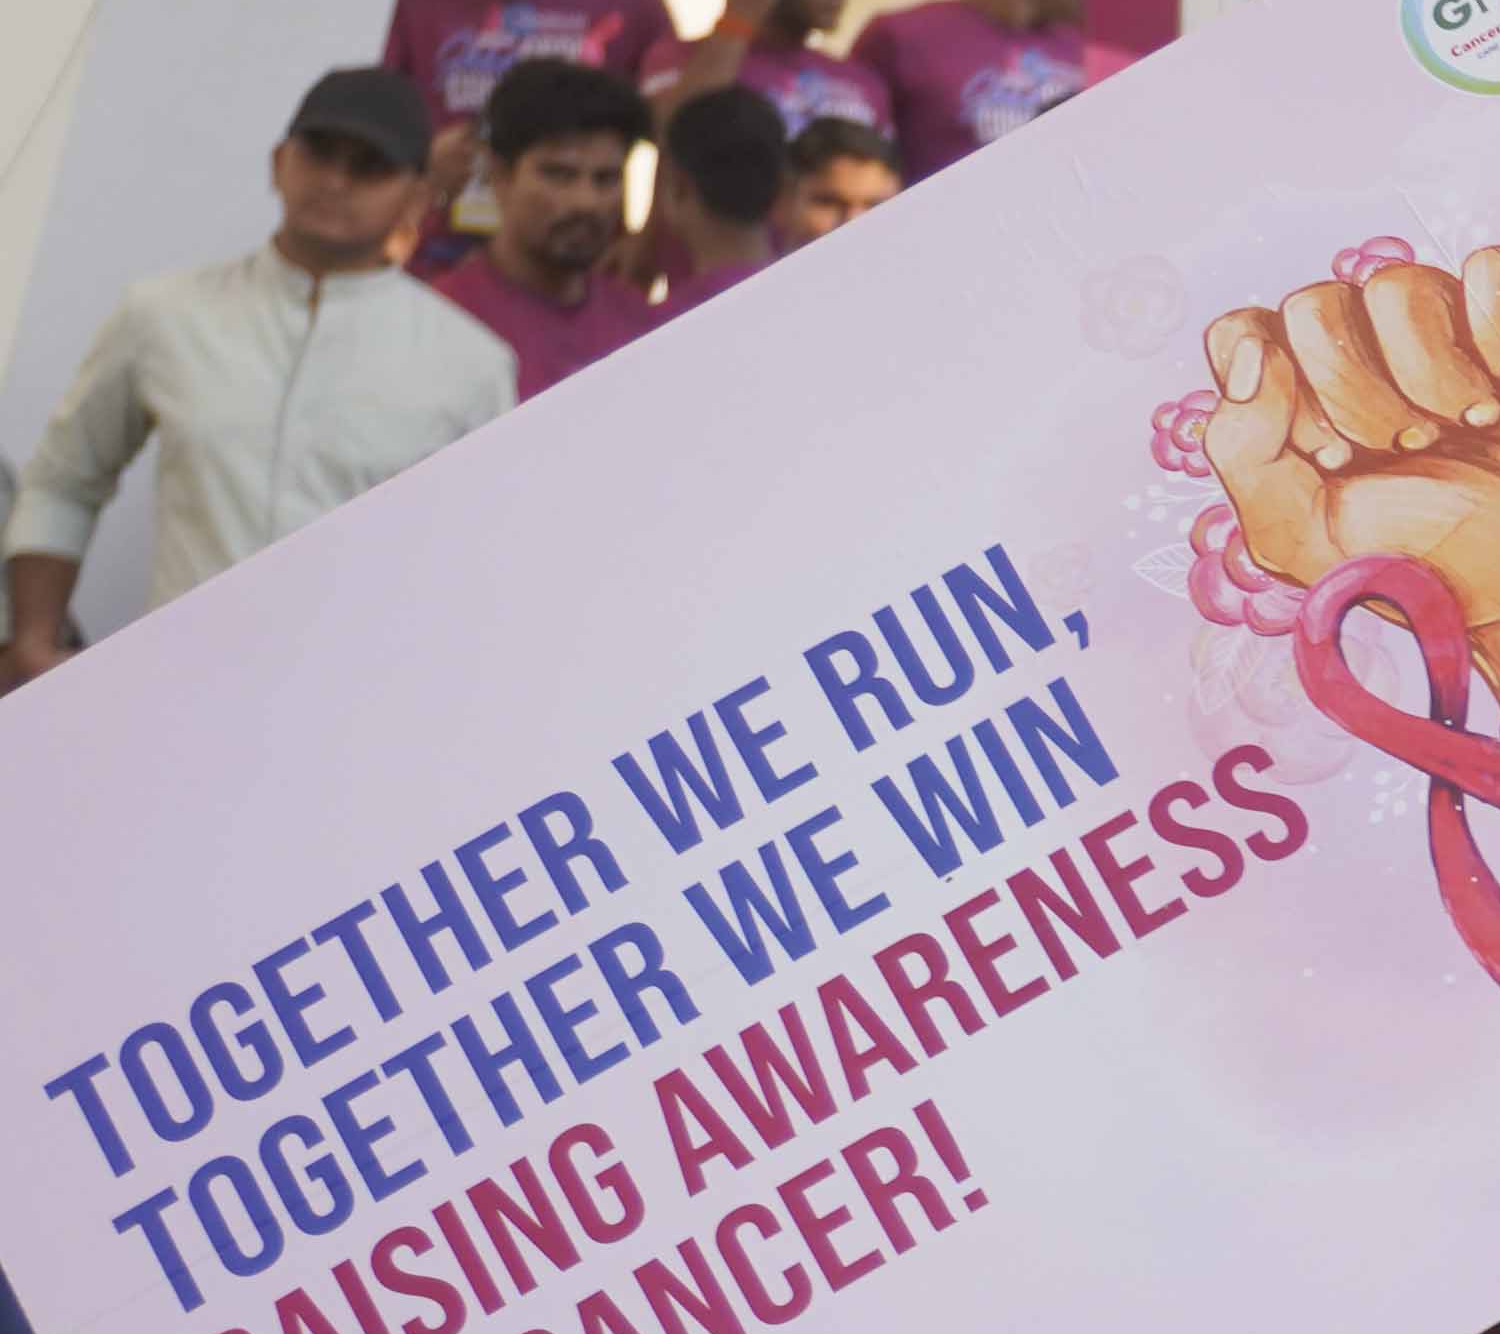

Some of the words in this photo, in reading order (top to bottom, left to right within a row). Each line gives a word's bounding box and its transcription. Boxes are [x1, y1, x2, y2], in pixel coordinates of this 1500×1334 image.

[44, 791, 628, 1177] TOGETHER
[611, 676, 818, 854] WE
[803, 543, 1090, 752] RUN,
[113, 921, 701, 1313] TOGETHER
[683, 805, 891, 987] WE
[871, 677, 1120, 881] WIN
[652, 744, 1311, 1197] AWARENESS
